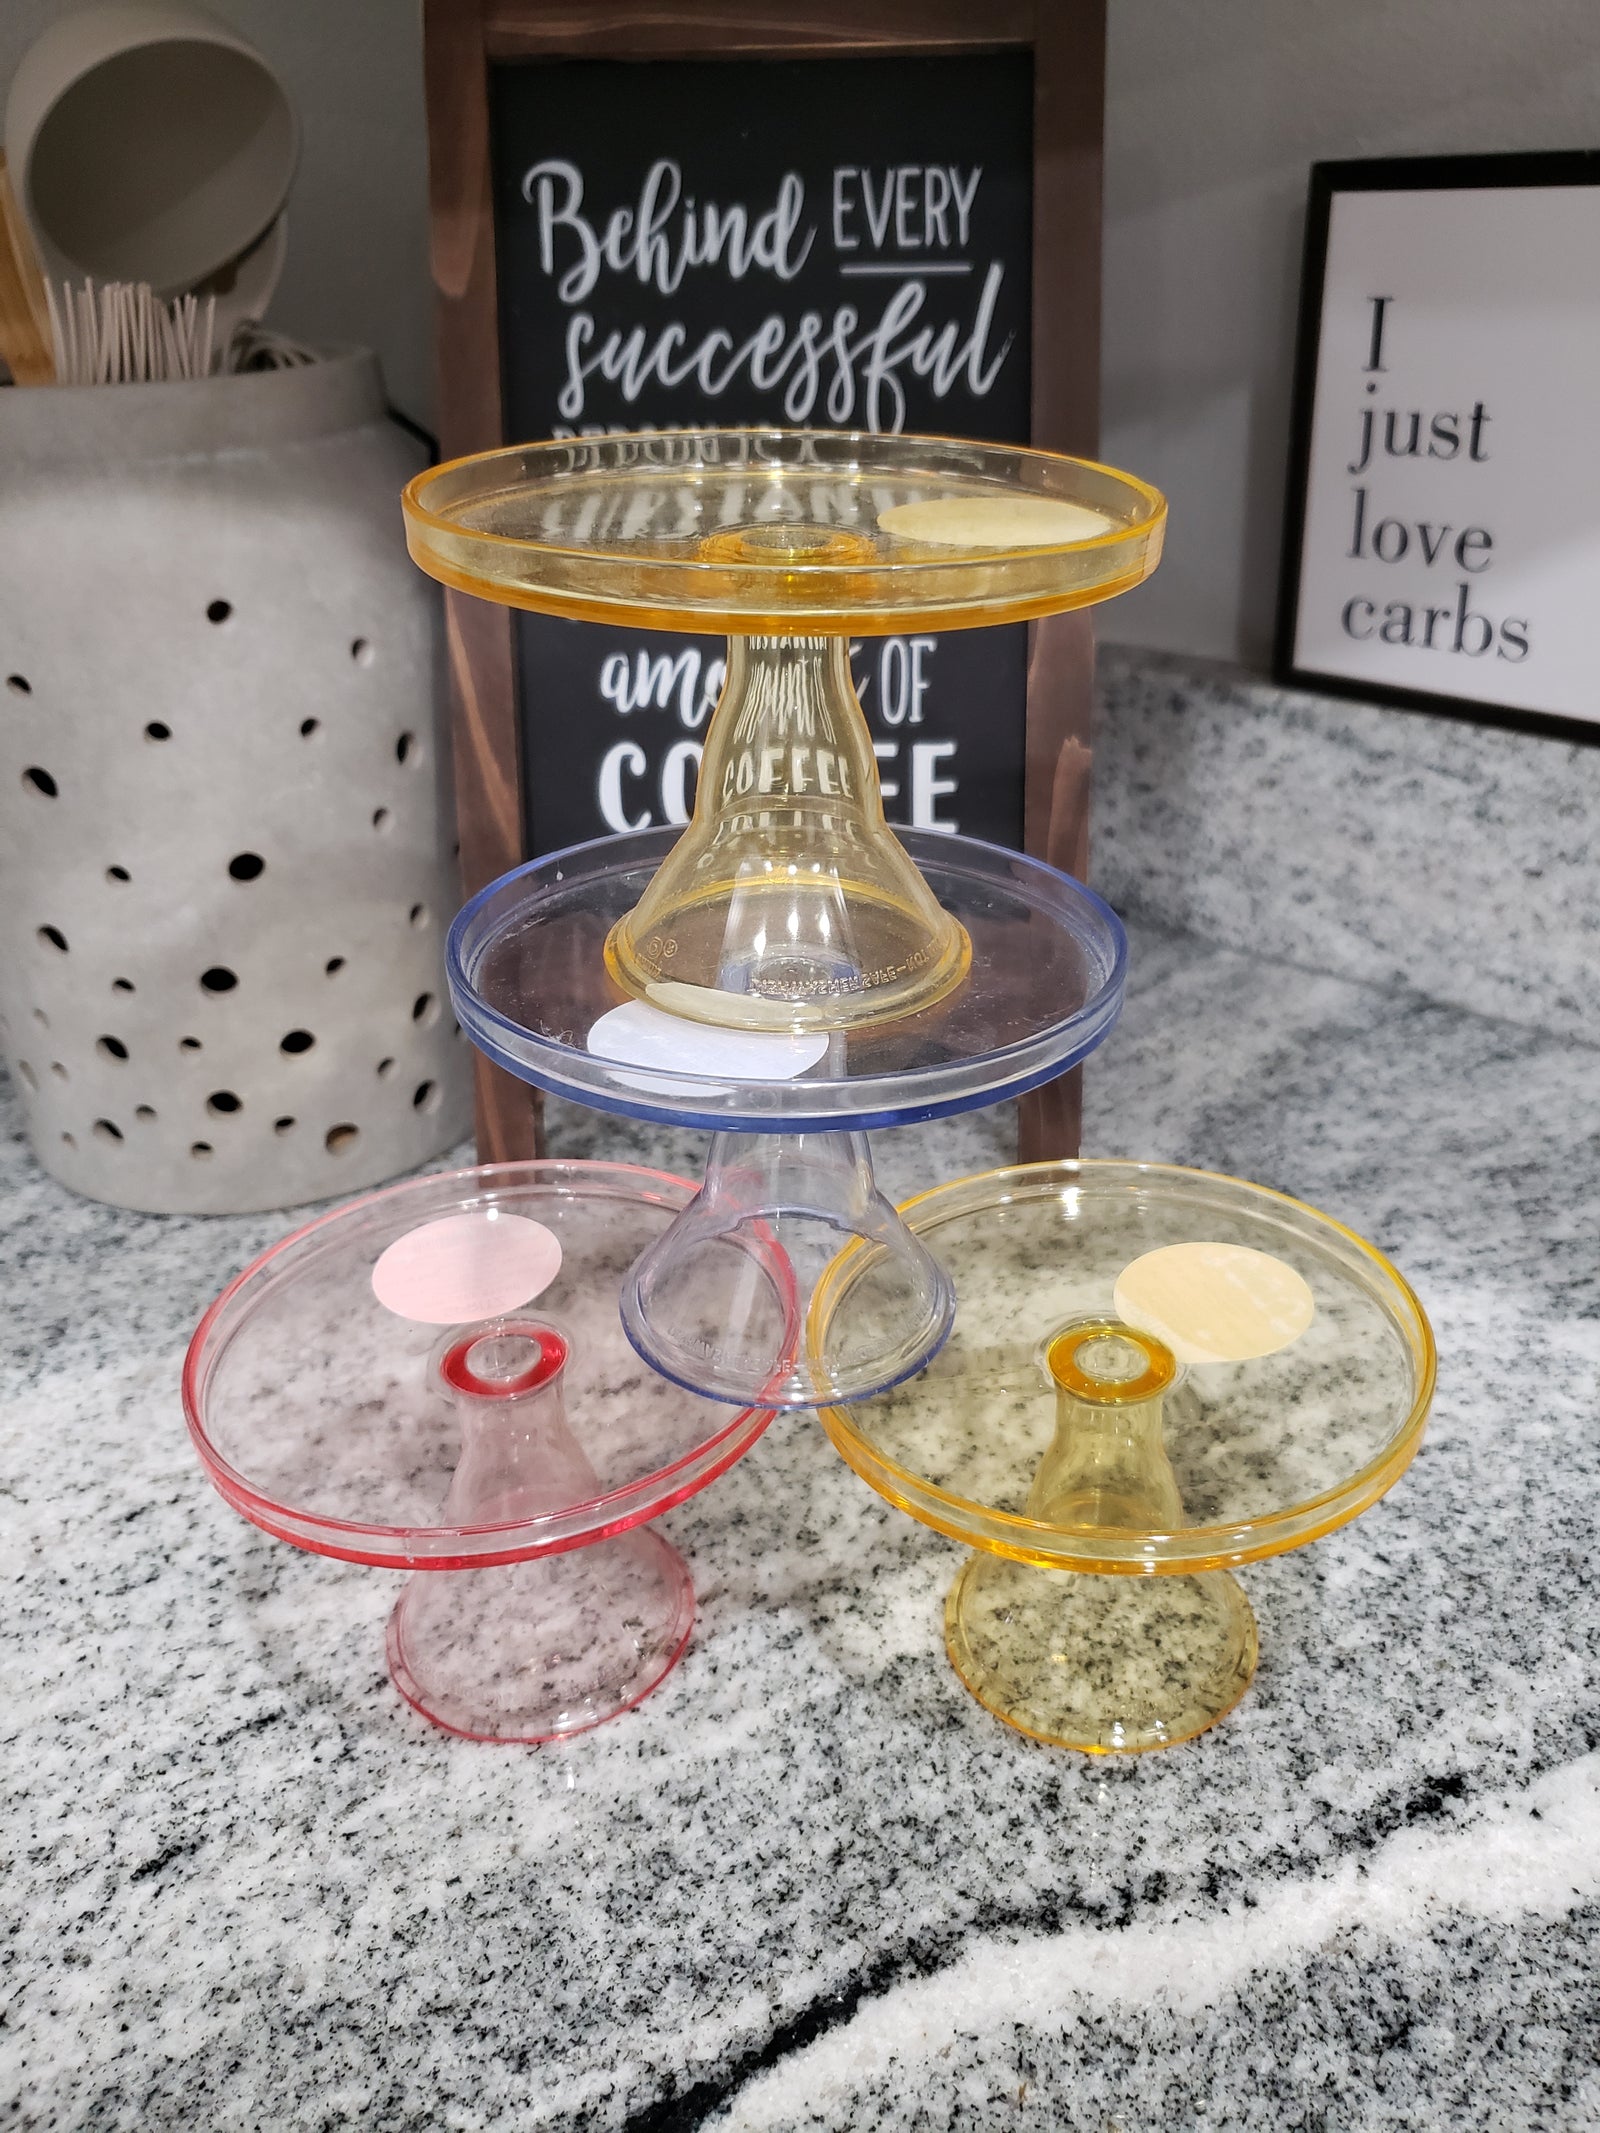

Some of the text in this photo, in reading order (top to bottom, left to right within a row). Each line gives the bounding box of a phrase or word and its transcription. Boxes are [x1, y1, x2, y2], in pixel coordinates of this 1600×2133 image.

[522, 158, 983, 305] Behind EVERY
[557, 263, 1017, 434] successful
[1361, 295, 1395, 373] I
[1346, 381, 1493, 475] just
[1345, 487, 1495, 573] love
[1340, 581, 1532, 664] carbs
[880, 636, 939, 725] OF
